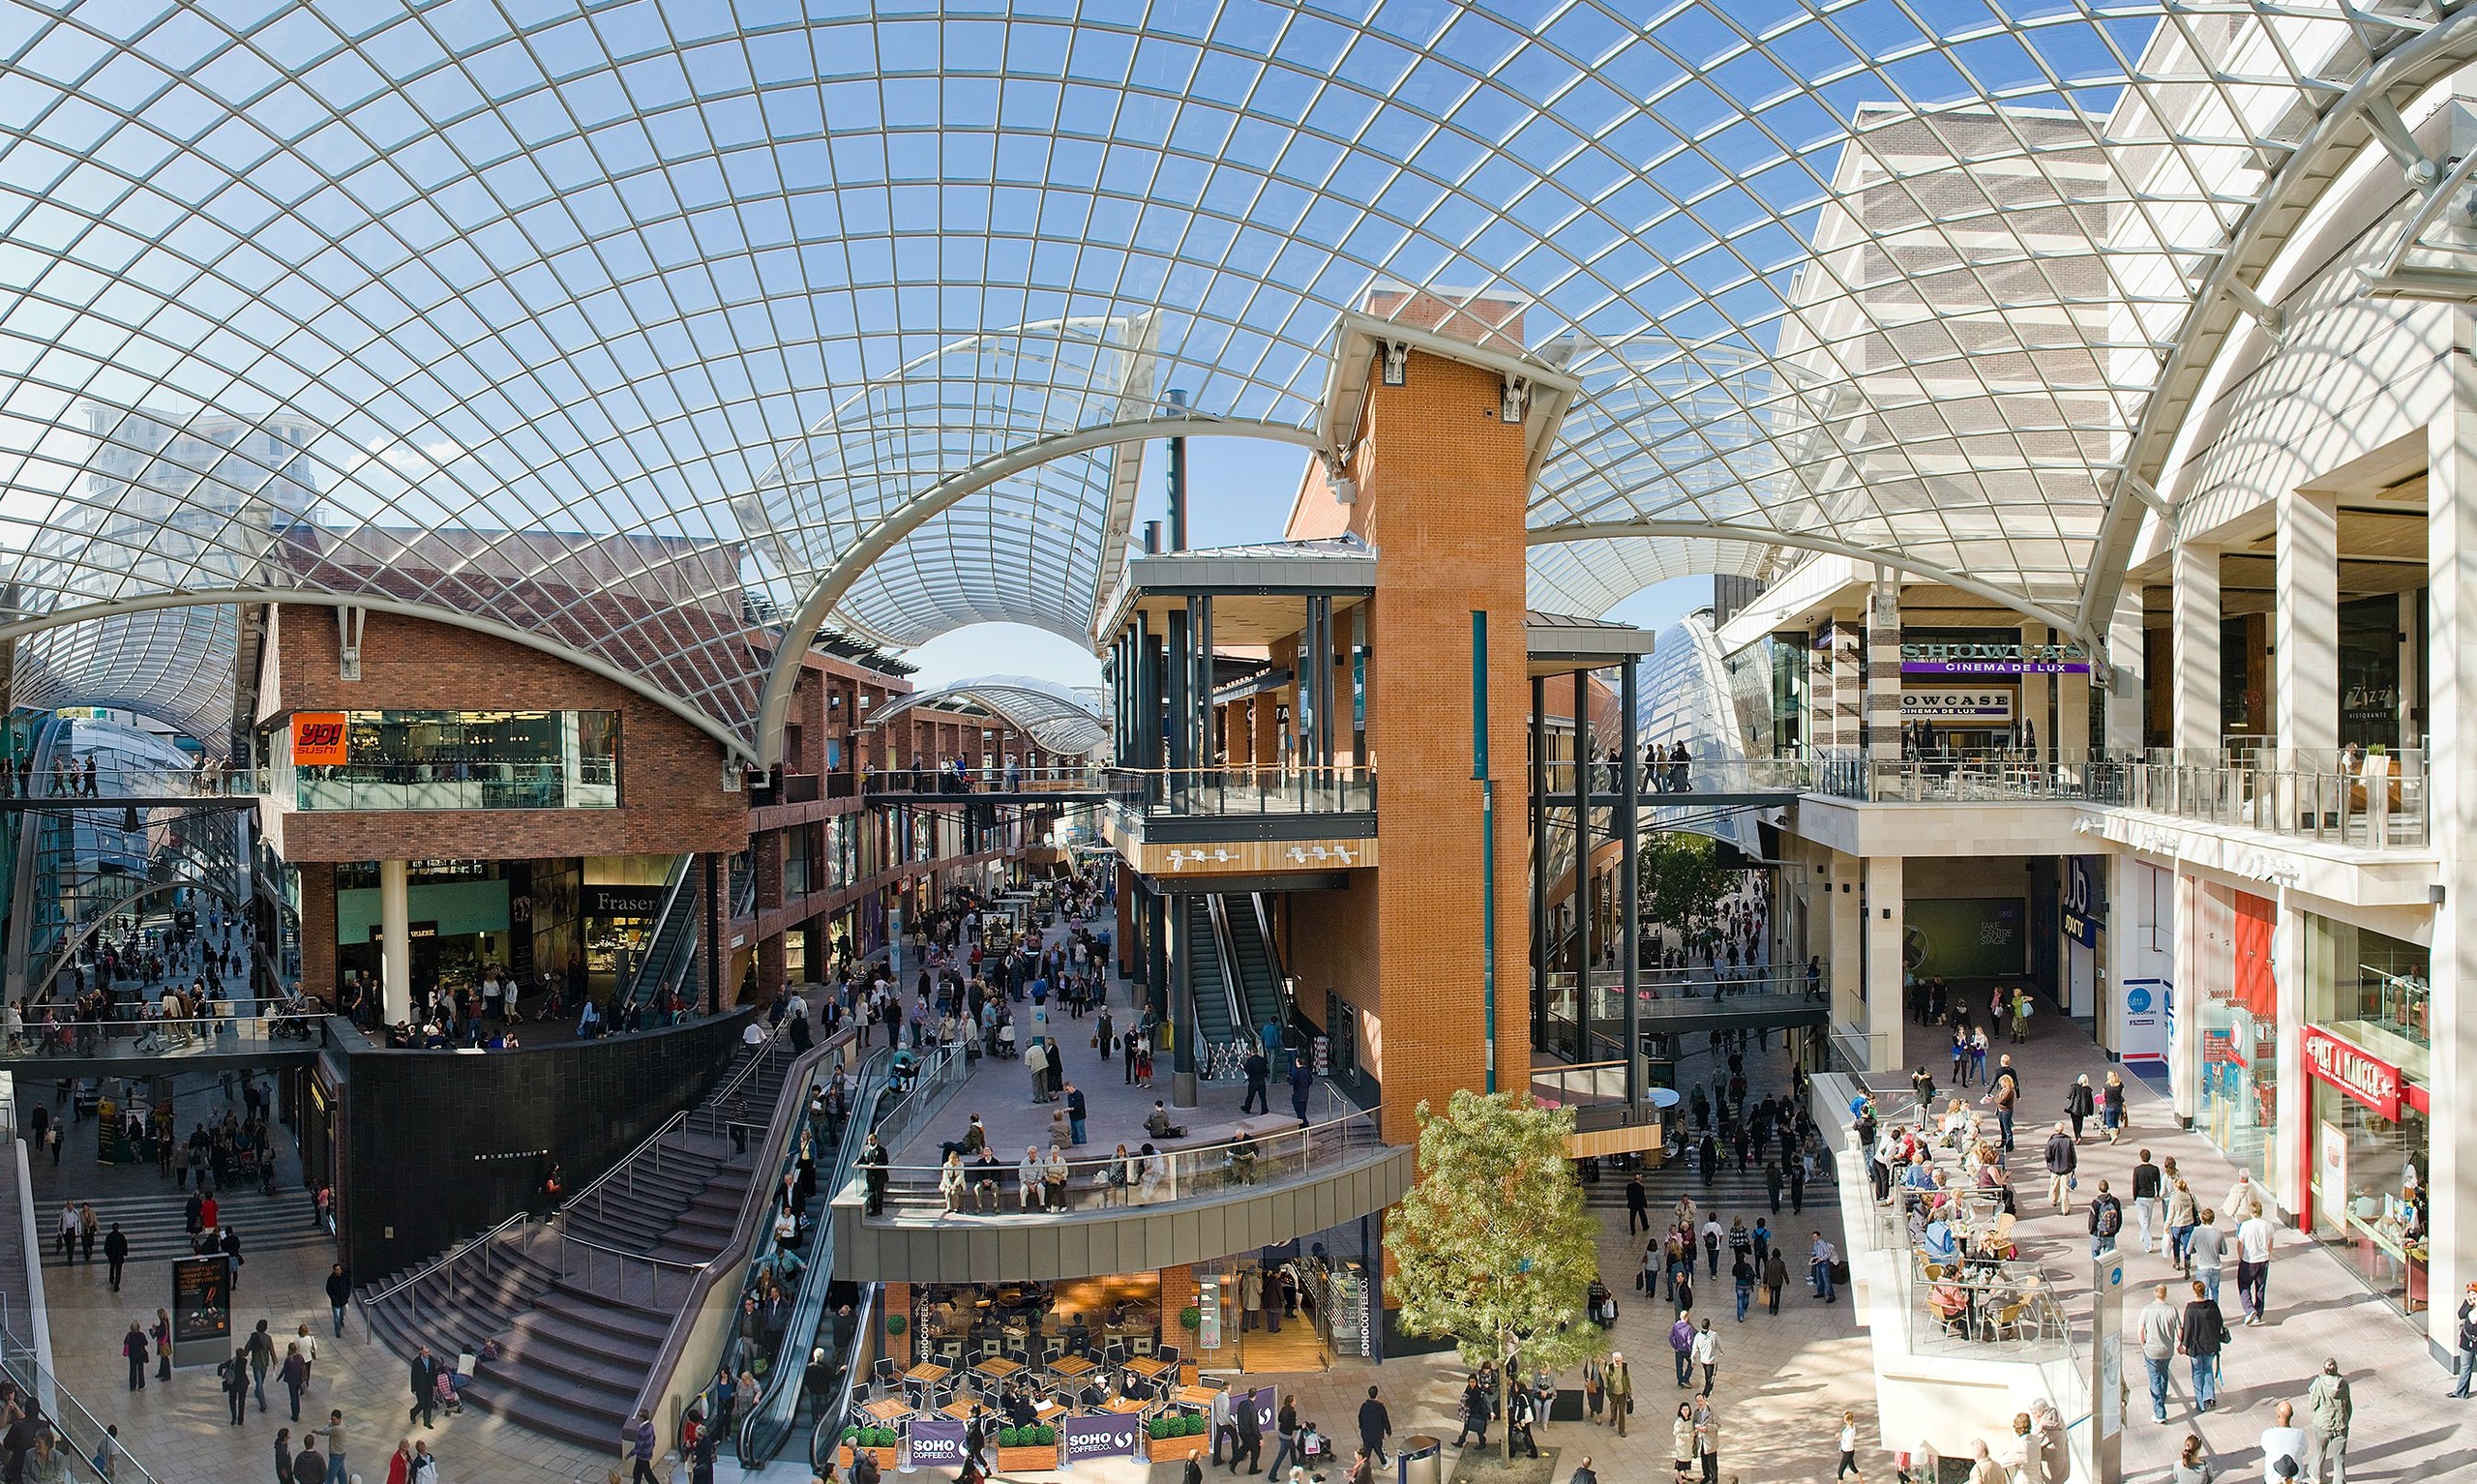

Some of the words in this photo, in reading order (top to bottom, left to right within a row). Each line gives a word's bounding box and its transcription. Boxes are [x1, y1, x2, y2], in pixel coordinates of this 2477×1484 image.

[1900, 643, 2085, 659] SHOWCAS
[1945, 663, 2006, 672] CINEMA
[2012, 664, 2032, 672] DE
[2037, 664, 2066, 672] LUX
[1902, 696, 2009, 706] OWCASE
[2352, 684, 2393, 708] Zizzi
[299, 724, 343, 746] YO!
[597, 892, 657, 910] Fraser
[1980, 921, 2000, 930] TAKE
[1980, 929, 2013, 937] CENTRE
[1980, 936, 2007, 945] STAGE
[1359, 1277, 1370, 1357] SOHOCOFFEECO.
[912, 1439, 955, 1451] SOHO
[1068, 1432, 1112, 1446] SOHO
[1068, 1443, 1112, 1454] COFFEECO.
